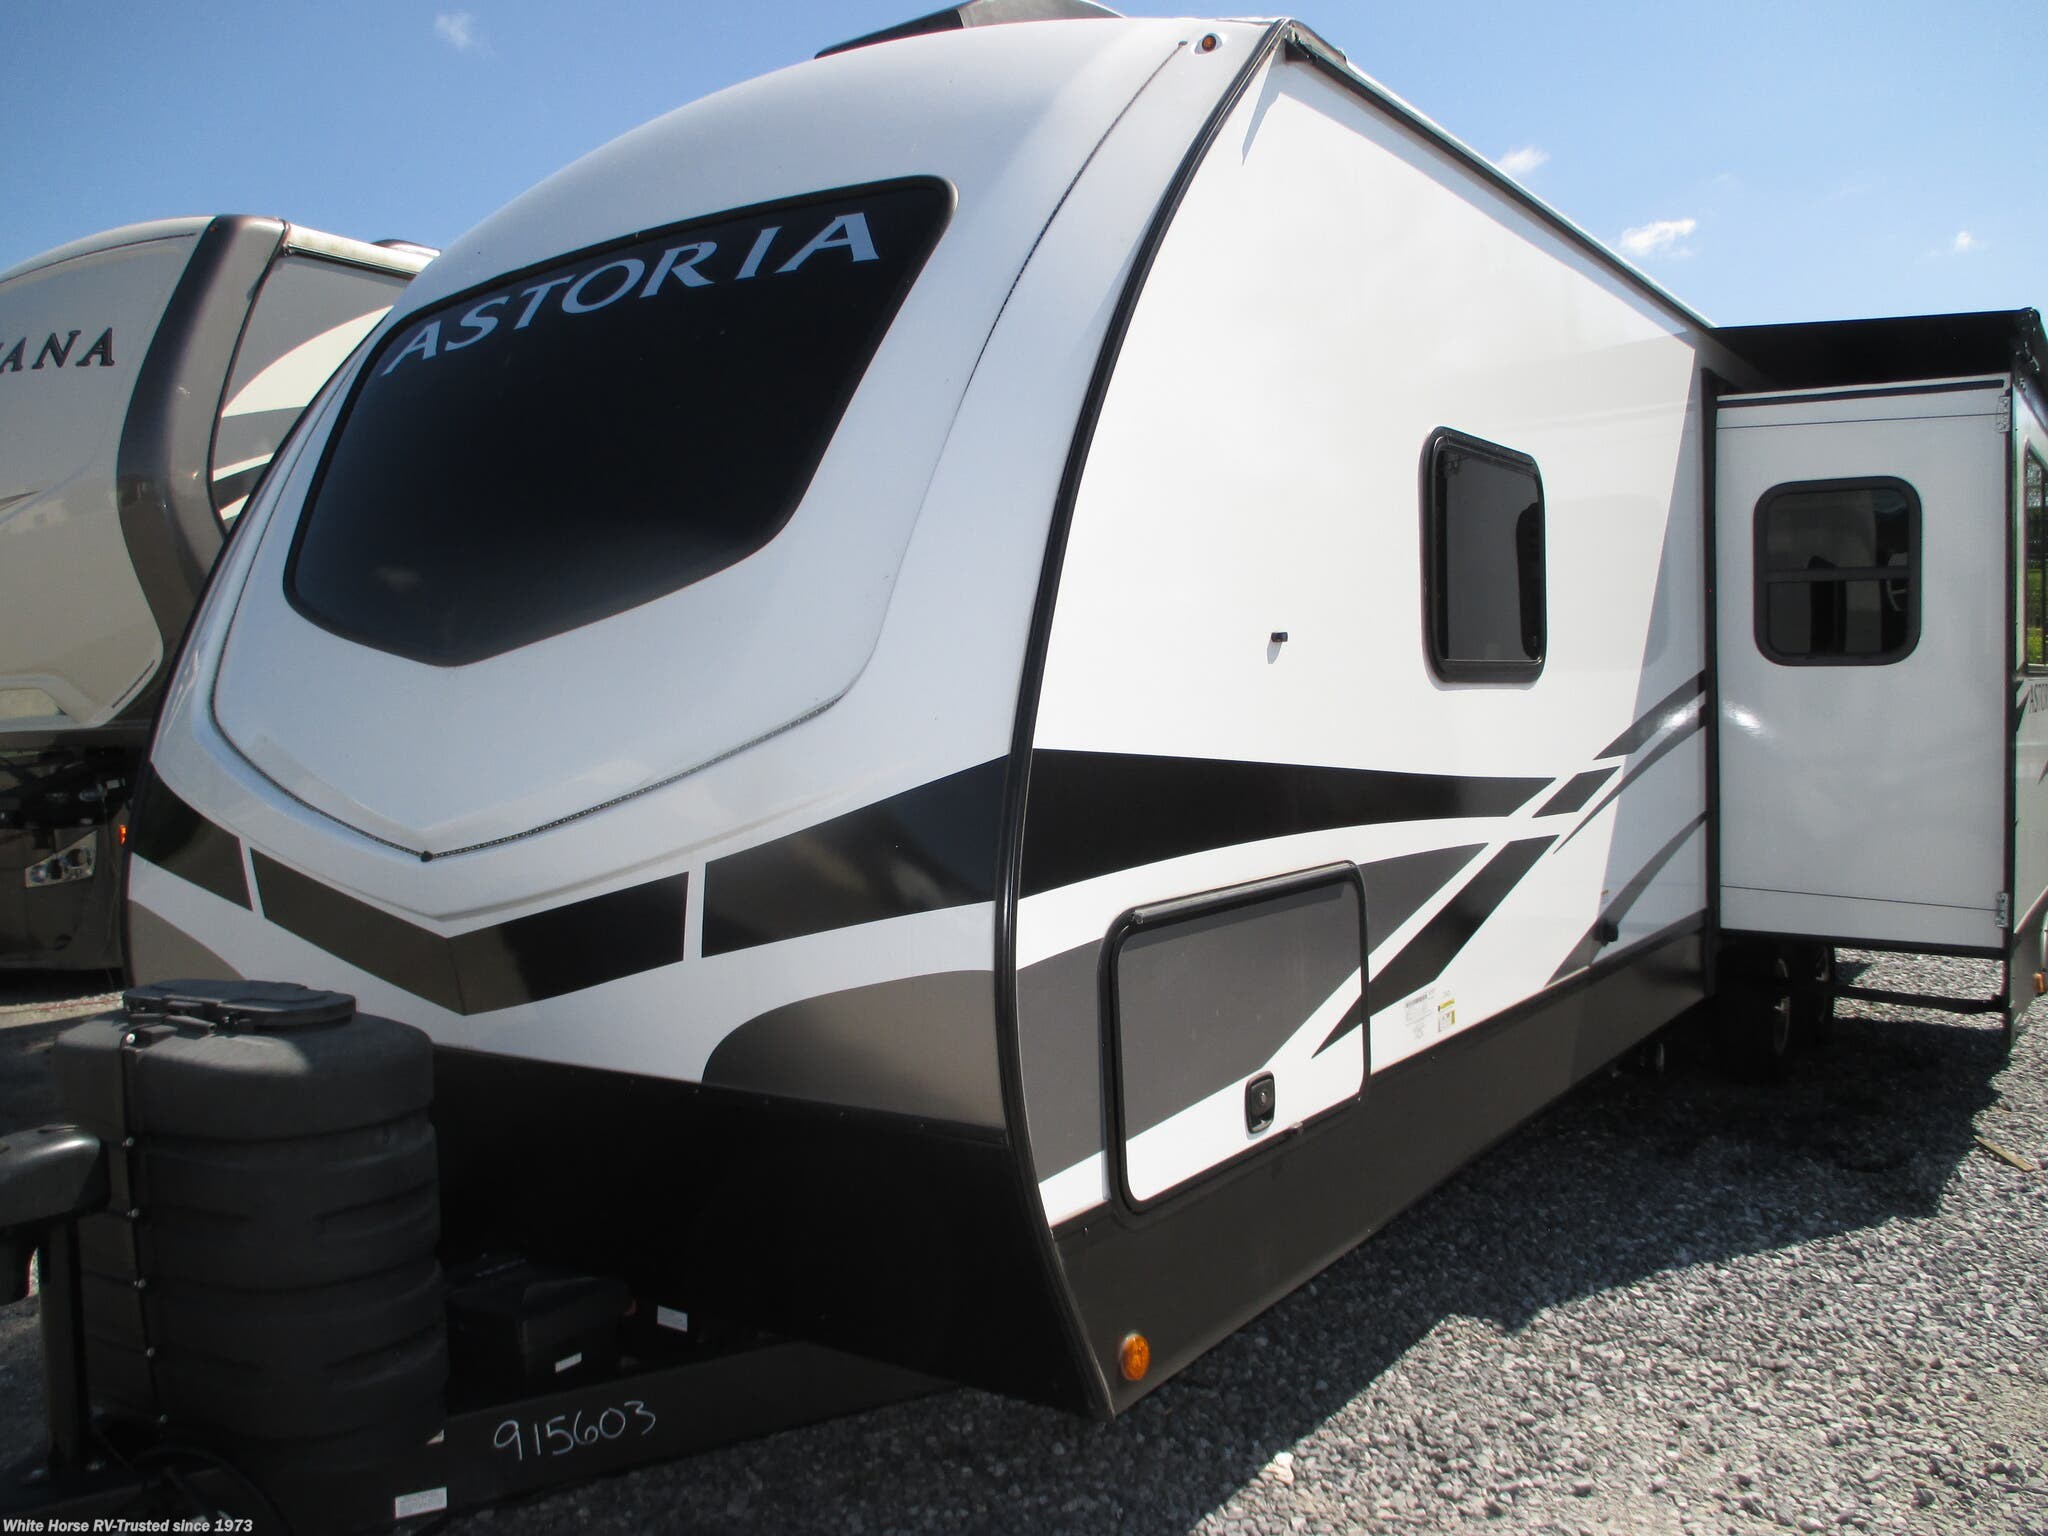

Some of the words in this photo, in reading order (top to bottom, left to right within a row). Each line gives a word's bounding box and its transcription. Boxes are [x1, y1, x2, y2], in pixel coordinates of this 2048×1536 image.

[380, 212, 880, 376] ASTORIA
[0, 327, 115, 374] ANA
[494, 1400, 656, 1461] 915603
